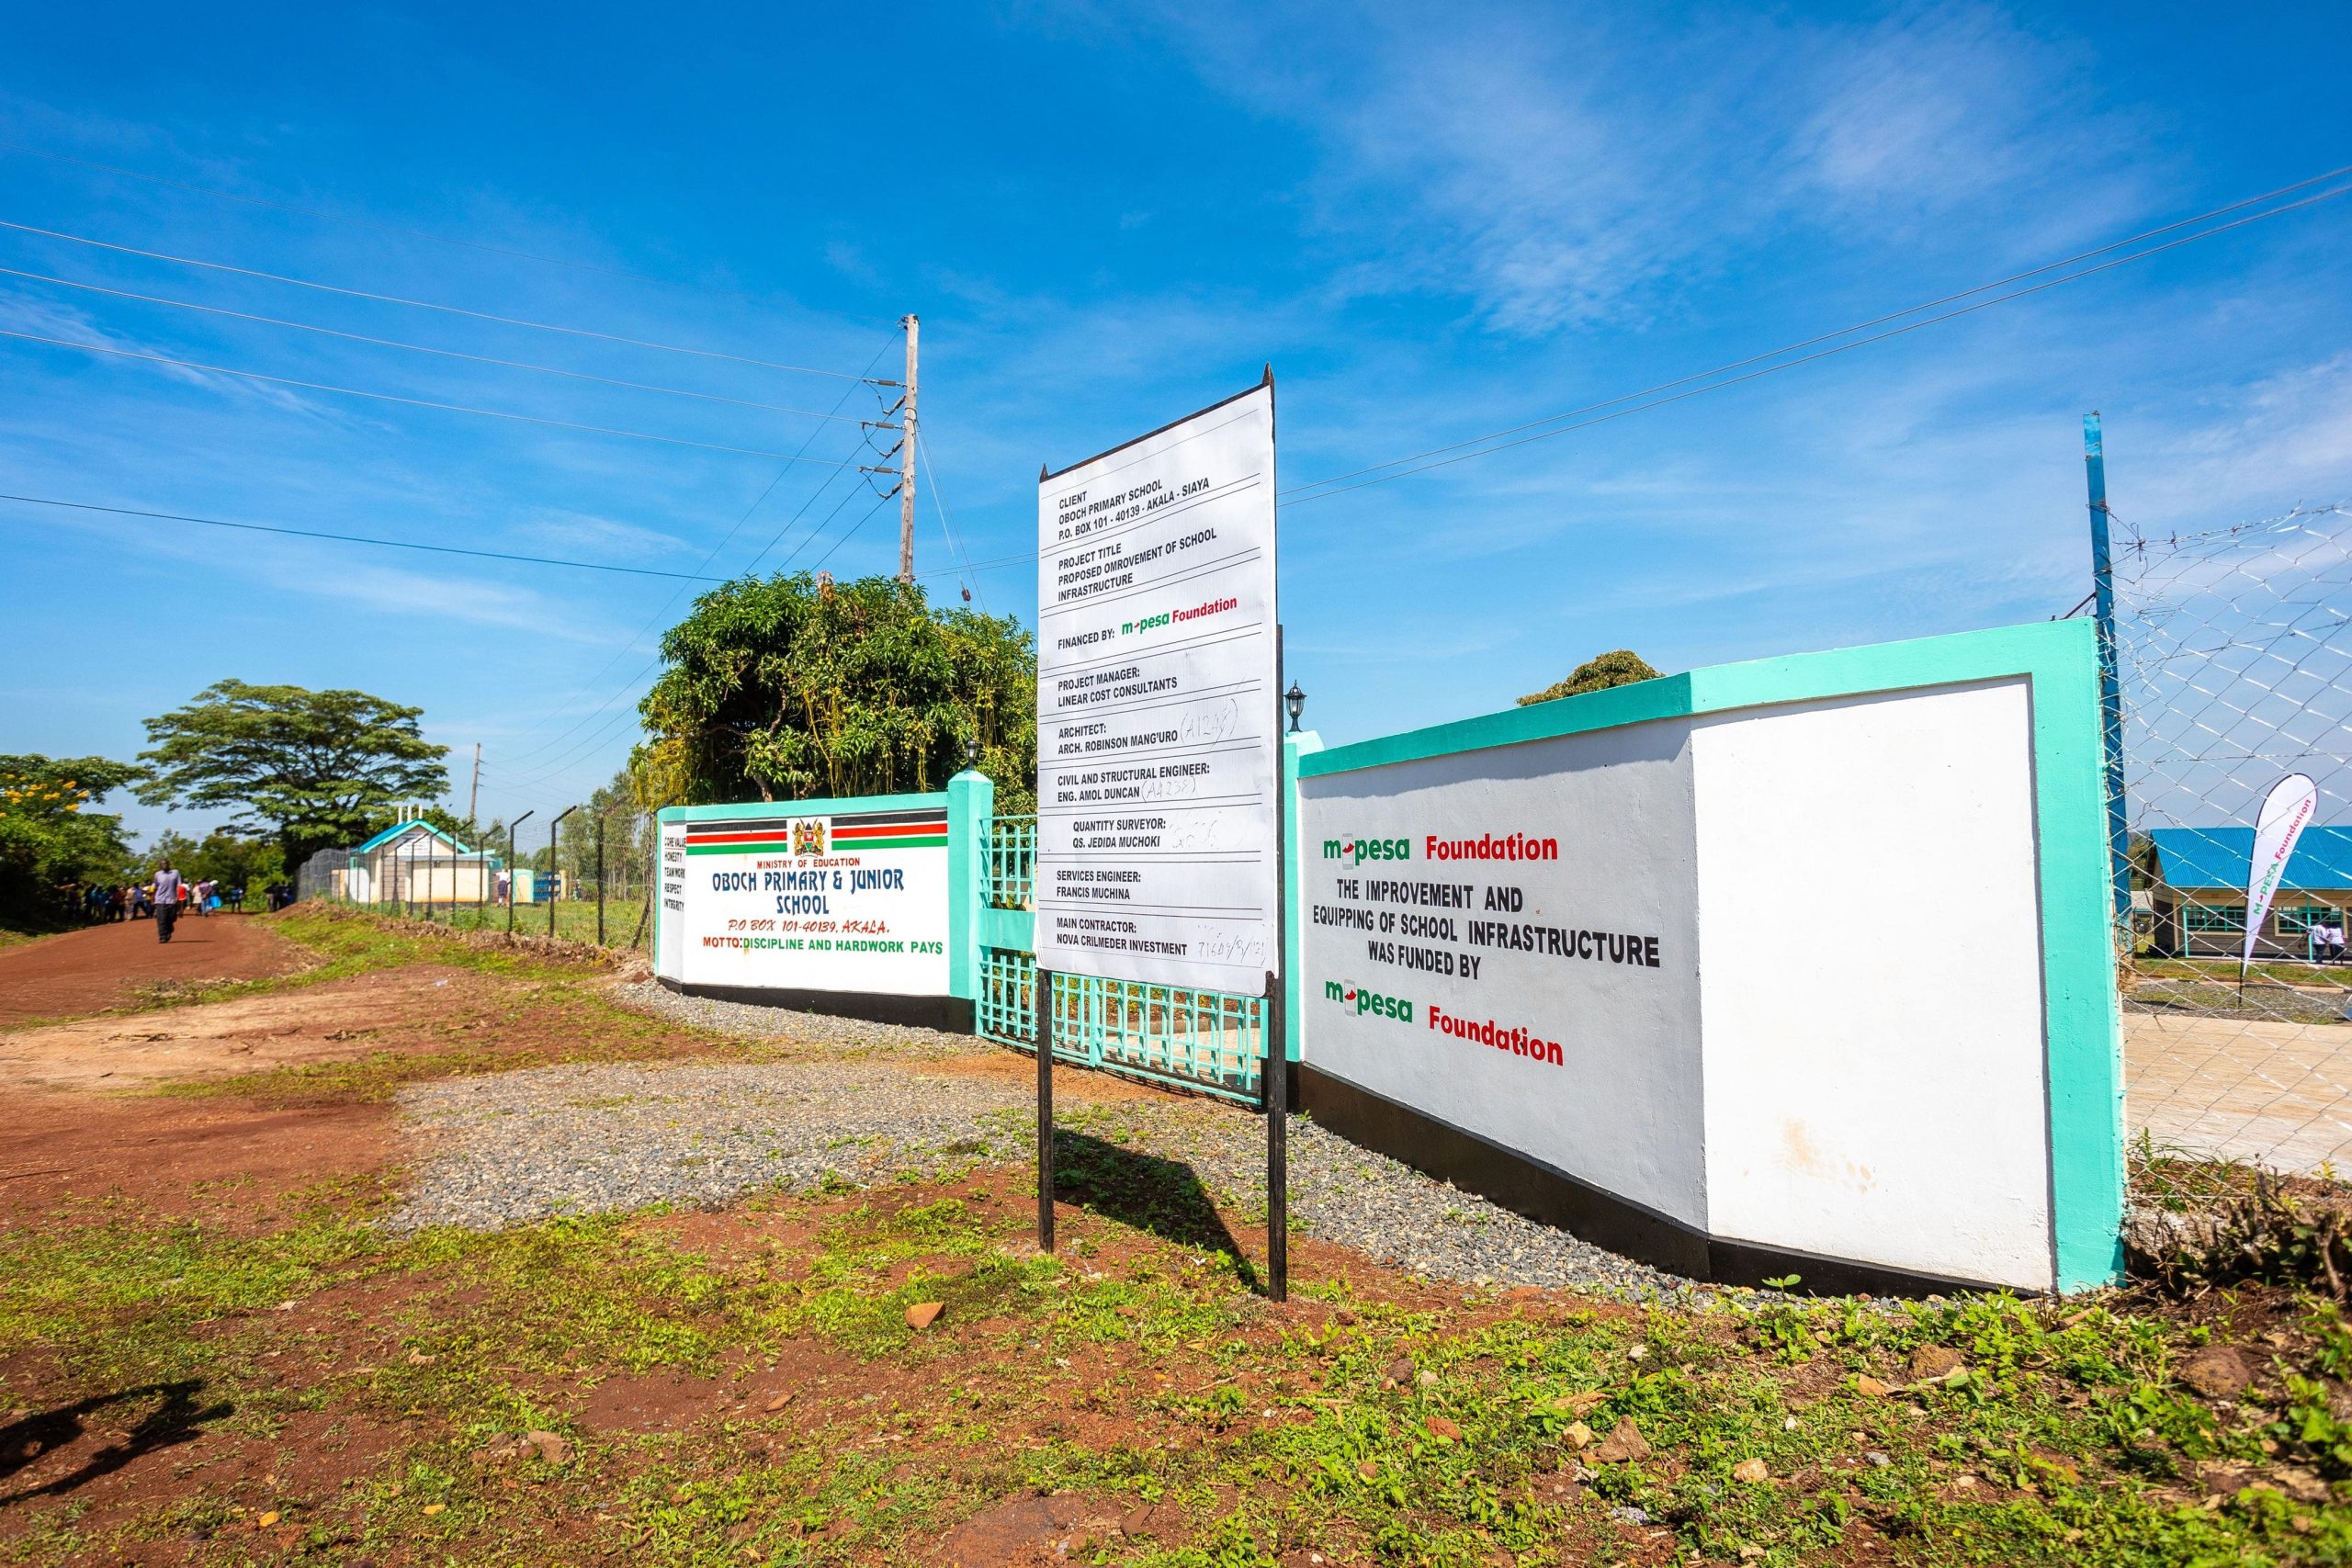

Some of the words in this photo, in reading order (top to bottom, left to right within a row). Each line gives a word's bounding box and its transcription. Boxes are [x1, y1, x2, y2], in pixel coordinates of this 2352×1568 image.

[1058, 509, 1087, 525] OBOCH
[1089, 493, 1126, 516] PRIMARY
[1128, 479, 1163, 501] SCHOOL
[1058, 527, 1073, 541] P.O.
[1075, 521, 1091, 536] BOX
[1093, 516, 1108, 532] 101
[1115, 504, 1140, 527] 40139
[1147, 491, 1175, 512] AKALA
[1182, 477, 1210, 497] SIAYA
[1059, 491, 1088, 510] CLIENT
[1058, 550, 1096, 570] PROJECT
[1098, 543, 1122, 560] TITLE
[1058, 565, 1102, 586] PROPOSED
[1104, 546, 1163, 574] OMROVEMENT
[1165, 540, 1177, 555] OF
[1179, 527, 1217, 550] SCHOOL
[1058, 572, 1134, 602] INFRASTRUCTURE
[1058, 632, 1099, 650] FINANCED
[1102, 628, 1115, 640] BY:
[1171, 596, 1238, 624] Foundation
[1058, 675, 1095, 692] PROJECT
[1096, 667, 1141, 684] MANAGER:
[1058, 693, 1089, 707] LINEAR
[1090, 688, 1111, 702] COST
[1113, 677, 1178, 698] CONSULTANTS
[1058, 723, 1106, 739] ARCHITECT:
[1058, 741, 1084, 755] ARCH.
[1085, 735, 1128, 752] ROBINSON
[1130, 729, 1178, 746] MANG'URO
[1057, 773, 1080, 786] CIVIL
[1080, 771, 1099, 784] AND
[1101, 766, 1157, 783] STRUCTURAL
[1159, 762, 1210, 779] ENGINEER:
[1057, 791, 1078, 803] ENG.
[1079, 789, 1102, 800] AMOL
[1103, 786, 1140, 799] DUNCAN
[1073, 819, 1114, 832] QUANTITY
[1116, 818, 1166, 830] SURVEYOR:
[2274, 798, 2312, 861] Foundation
[1073, 837, 1086, 849] QS.
[1087, 837, 1116, 849] JEDIDA
[1118, 836, 1160, 848] MUCHOKI
[1426, 832, 1558, 862] Foundation
[757, 859, 793, 870] MINISTRY
[797, 858, 808, 868] OF
[813, 857, 861, 868] EDUCATION
[712, 872, 757, 893] OBOCH
[764, 871, 826, 895] PRIMARY
[832, 871, 842, 890] &
[851, 868, 905, 895] JUNIOR
[1057, 871, 1094, 882] SERVICES
[1096, 871, 1141, 883] ENGINEER:
[776, 895, 830, 915] SCHOOL
[1057, 886, 1090, 898] FRANCIS
[1091, 887, 1130, 900] MUCHINA
[1337, 878, 1359, 900] THE
[1365, 879, 1474, 909] IMPROVEMENT
[1485, 886, 1523, 913] AND
[751, 919, 776, 931] BOX
[1057, 918, 1078, 930] MAIN
[1079, 919, 1136, 934] CONTRACTOR:
[1313, 905, 1374, 931] EQUIPPING
[1379, 912, 1396, 933] OF
[1400, 913, 1458, 942] SCHOOL
[1469, 919, 1660, 968] INFRASTRUCTURE
[808, 939, 831, 951] AND
[836, 940, 904, 953] HARDWORK
[910, 942, 944, 955] PAYS
[1057, 933, 1080, 945] NOVA
[1080, 935, 1127, 951] CRILMEDER
[1129, 941, 1187, 956] INVESTMENT
[1368, 940, 1395, 965] WAS
[1398, 944, 1454, 976] FUNDED
[1460, 953, 1481, 980] BY
[1429, 1005, 1564, 1066] Foundation
